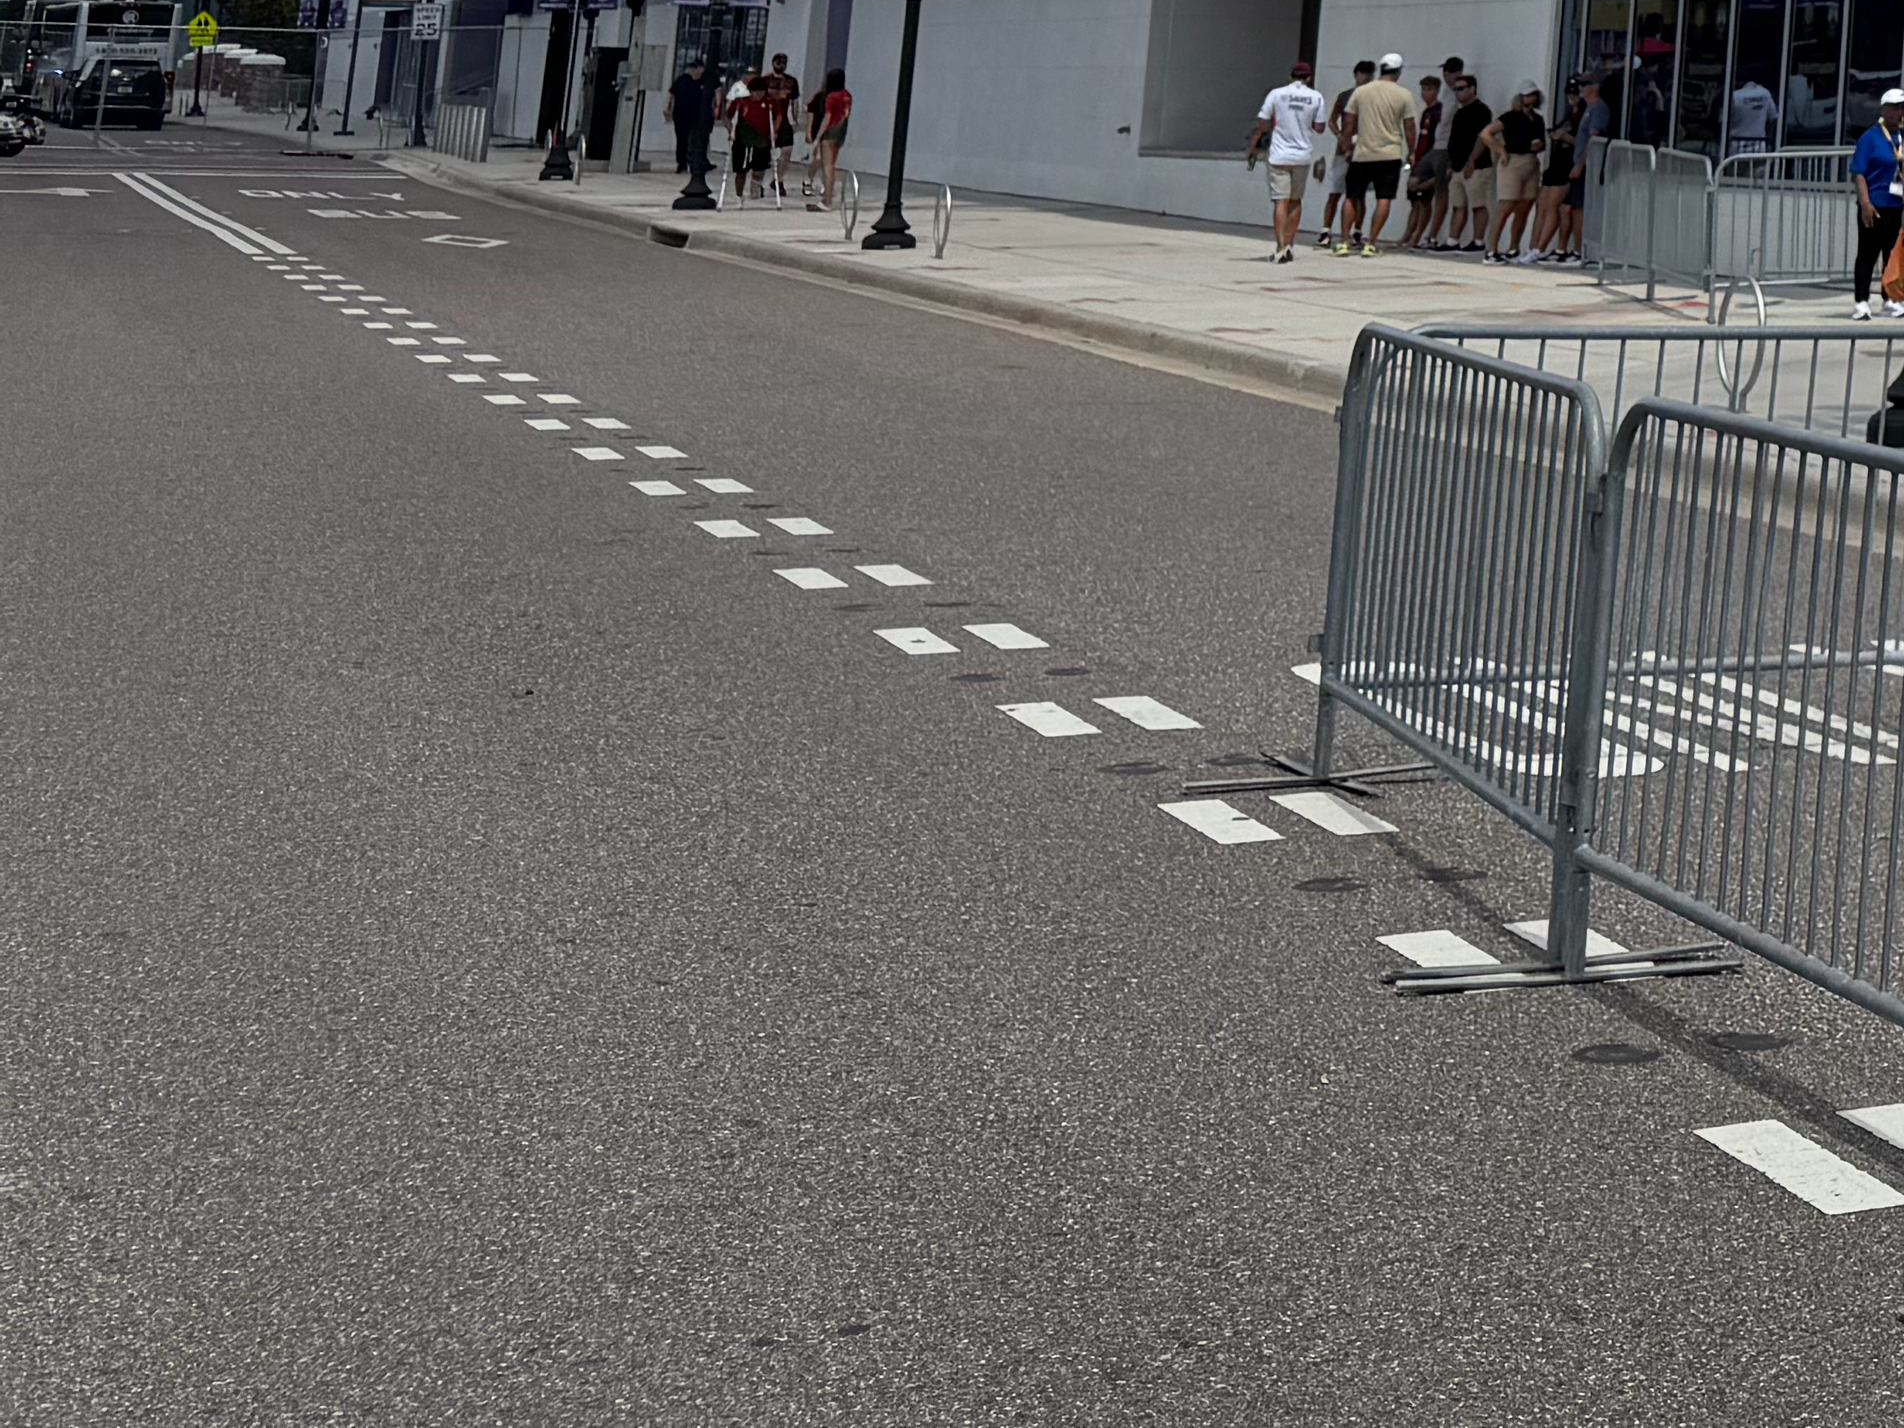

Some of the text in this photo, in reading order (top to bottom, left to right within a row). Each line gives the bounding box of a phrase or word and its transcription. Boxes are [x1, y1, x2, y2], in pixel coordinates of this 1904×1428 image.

[415, 23, 438, 37] 25
[238, 189, 406, 200] ONLY
[307, 209, 461, 220] BUS
